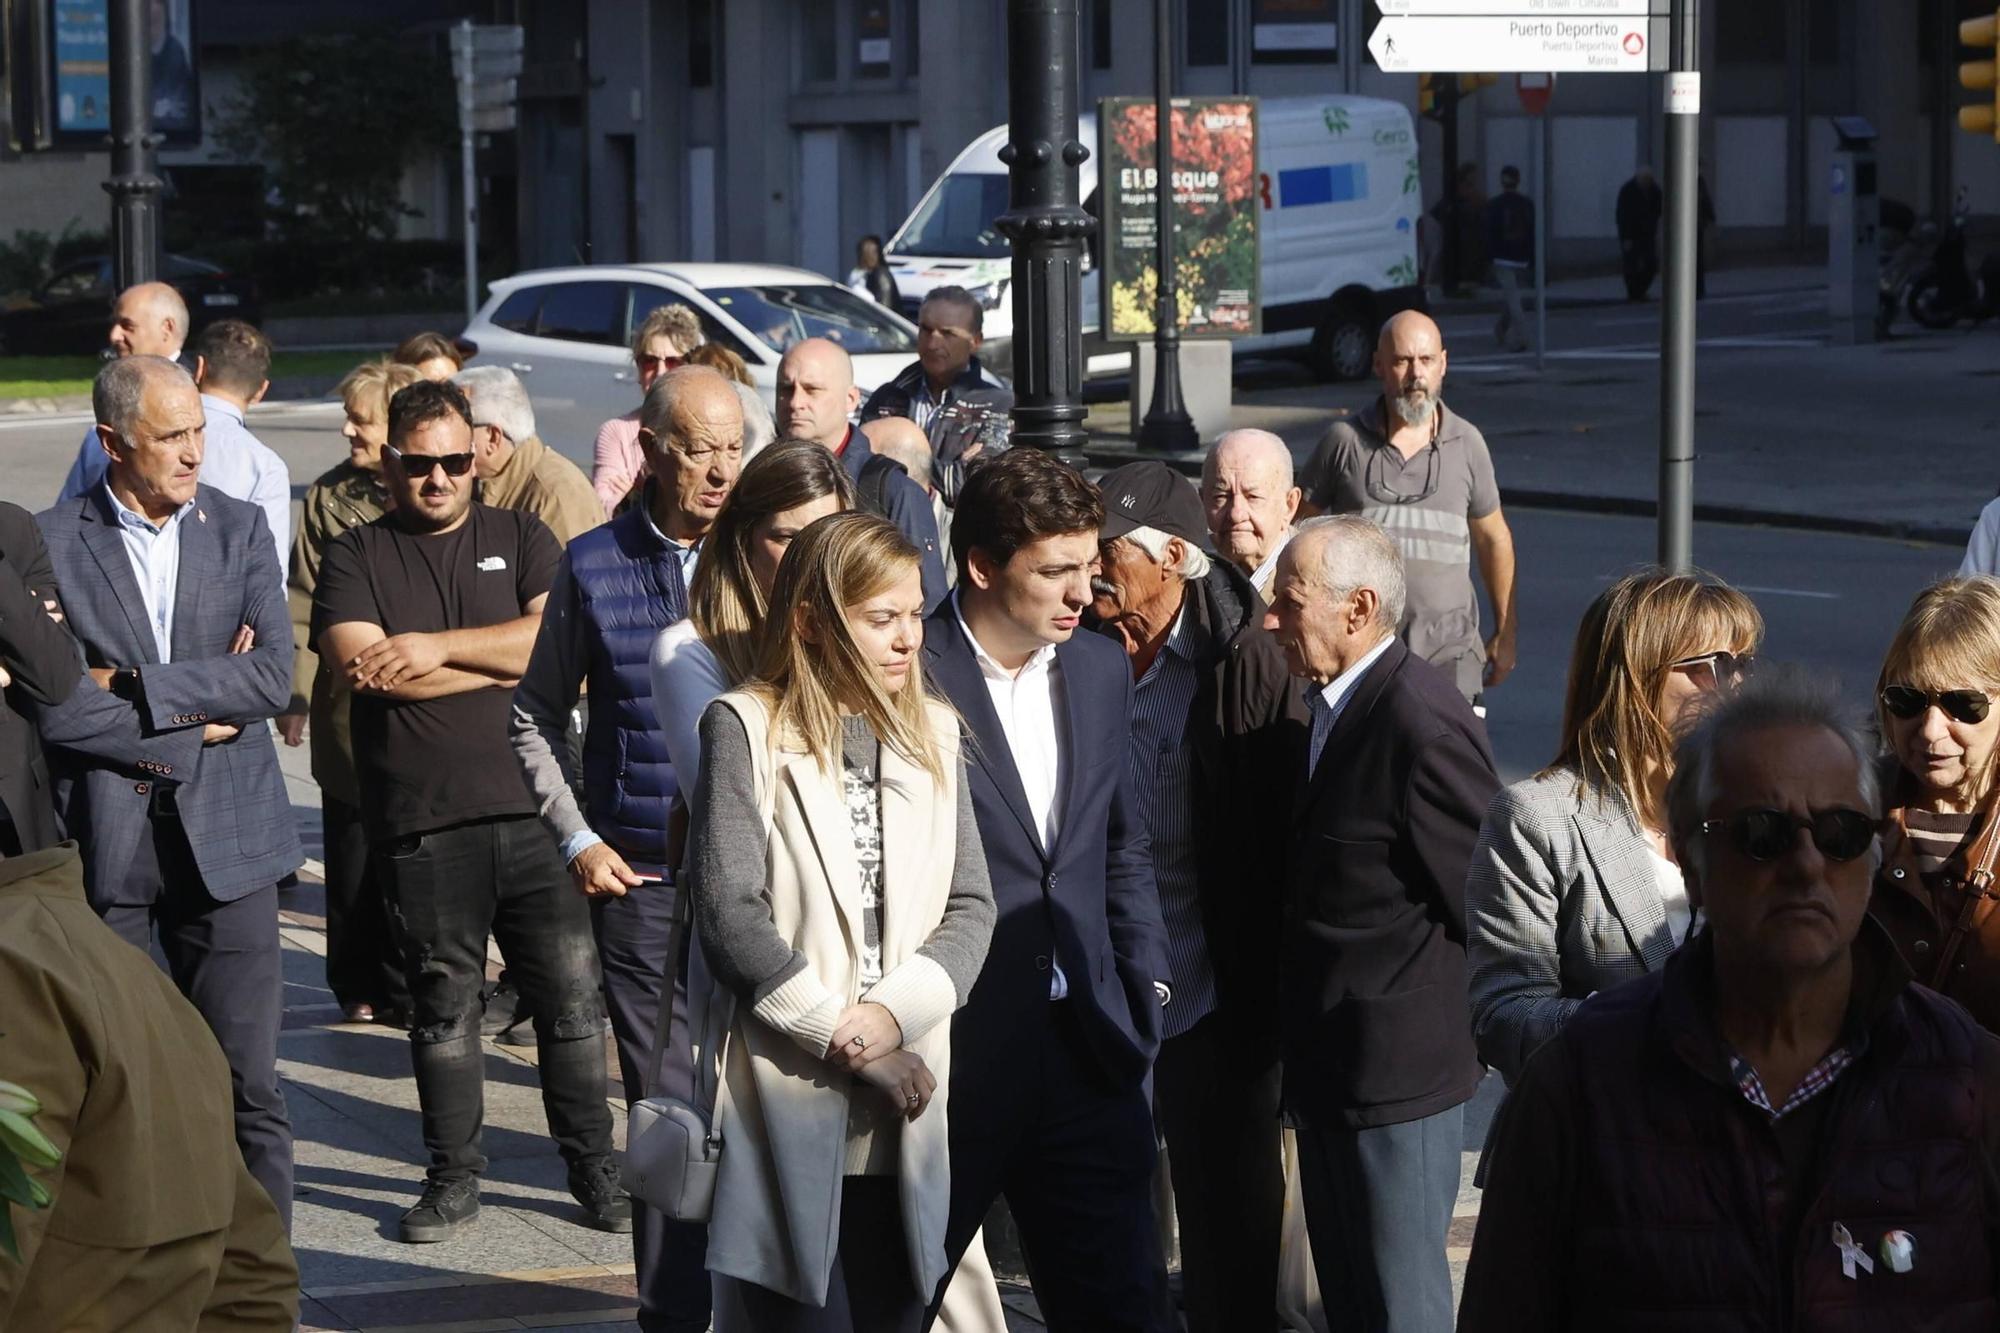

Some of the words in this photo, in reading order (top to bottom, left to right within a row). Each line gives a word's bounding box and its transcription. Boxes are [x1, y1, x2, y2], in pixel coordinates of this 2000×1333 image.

[1510, 21, 1552, 36] Puerto
[1556, 21, 1618, 39] Deportivo
[1587, 55, 1618, 65] Marina
[1144, 168, 1218, 191] Bsque
